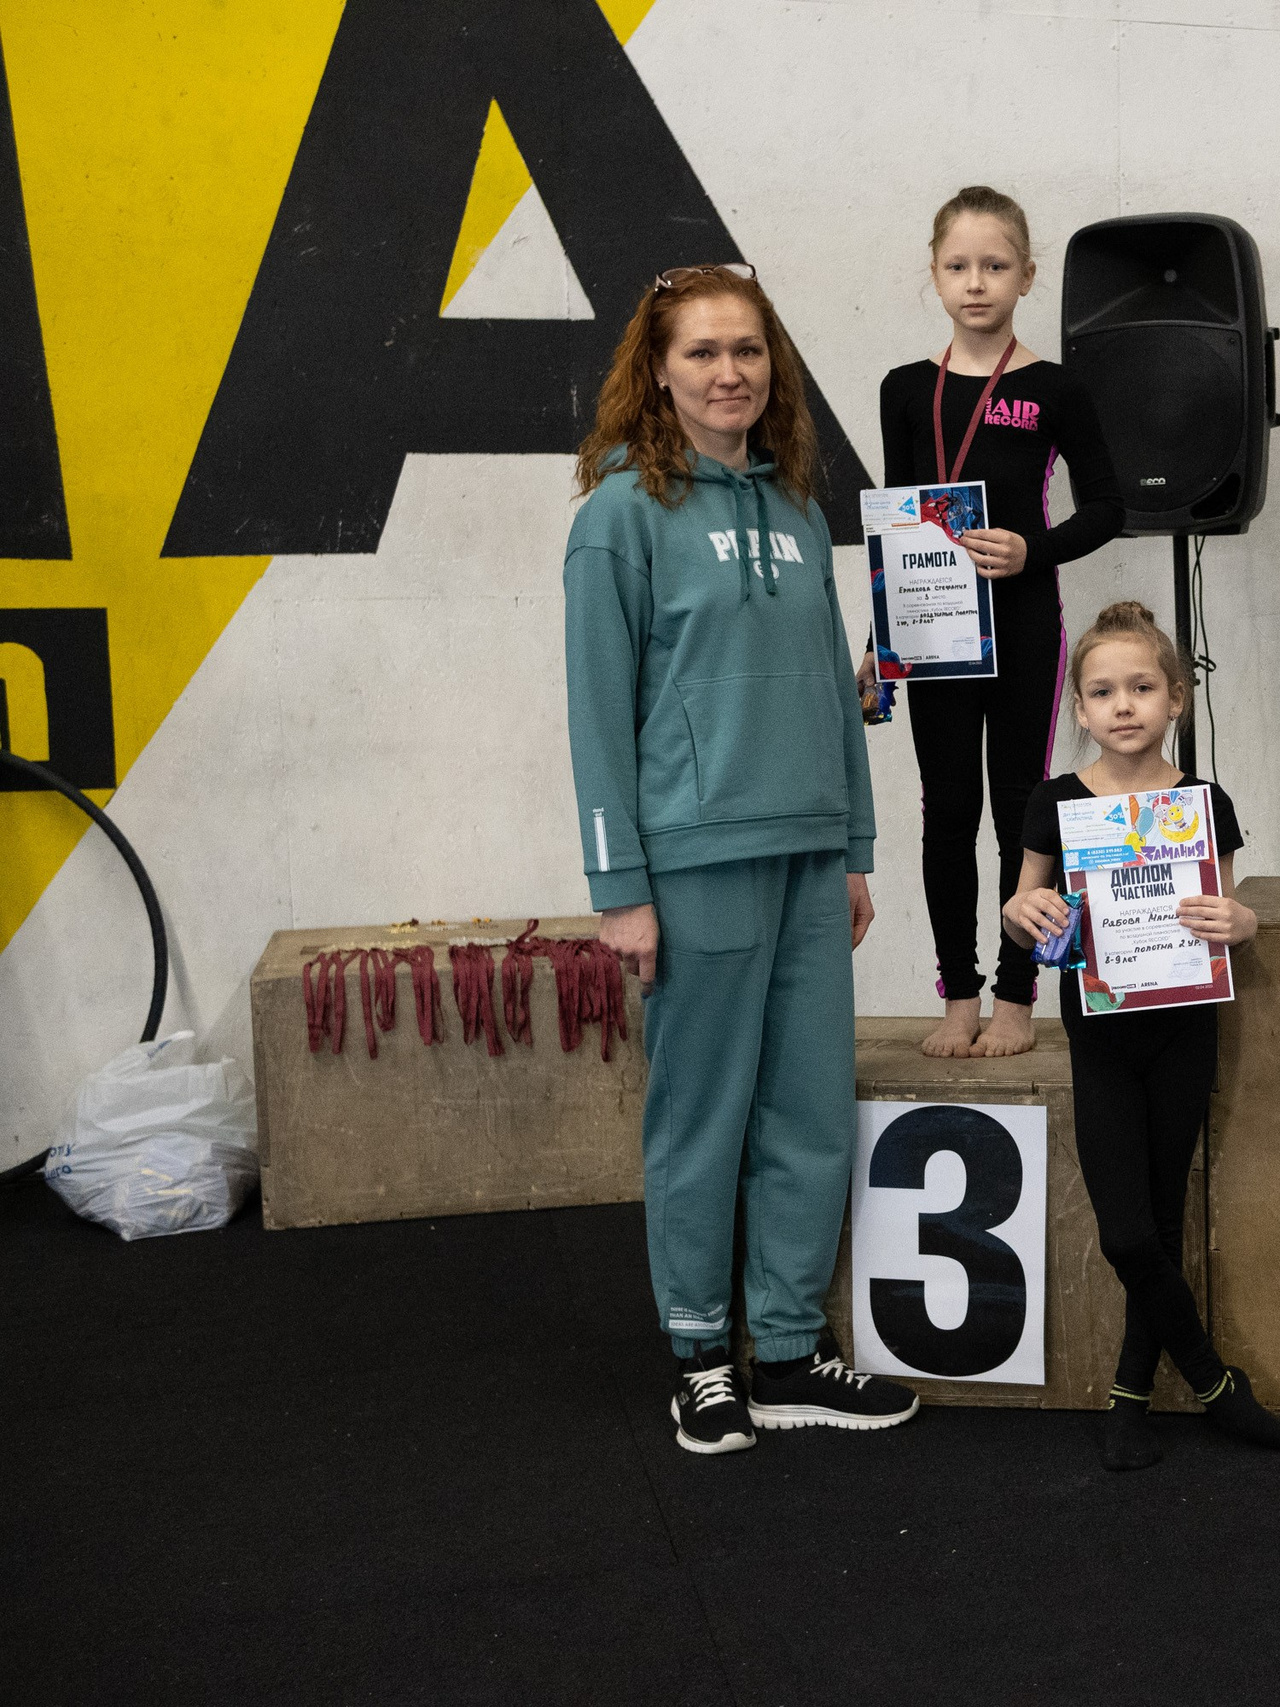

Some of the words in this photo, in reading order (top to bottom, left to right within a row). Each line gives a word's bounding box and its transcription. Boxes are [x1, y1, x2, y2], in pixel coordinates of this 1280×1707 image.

[991, 398, 1040, 420] AIR
[902, 551, 957, 569] ГРАМОТА
[1111, 863, 1172, 888] ДИПЛОМ
[1112, 882, 1175, 901] УЧАСТНИКА
[1120, 905, 1173, 916] НАГРАЖДАЕТСЯ
[1179, 939, 1185, 948] 2
[869, 1105, 1027, 1377] 3
